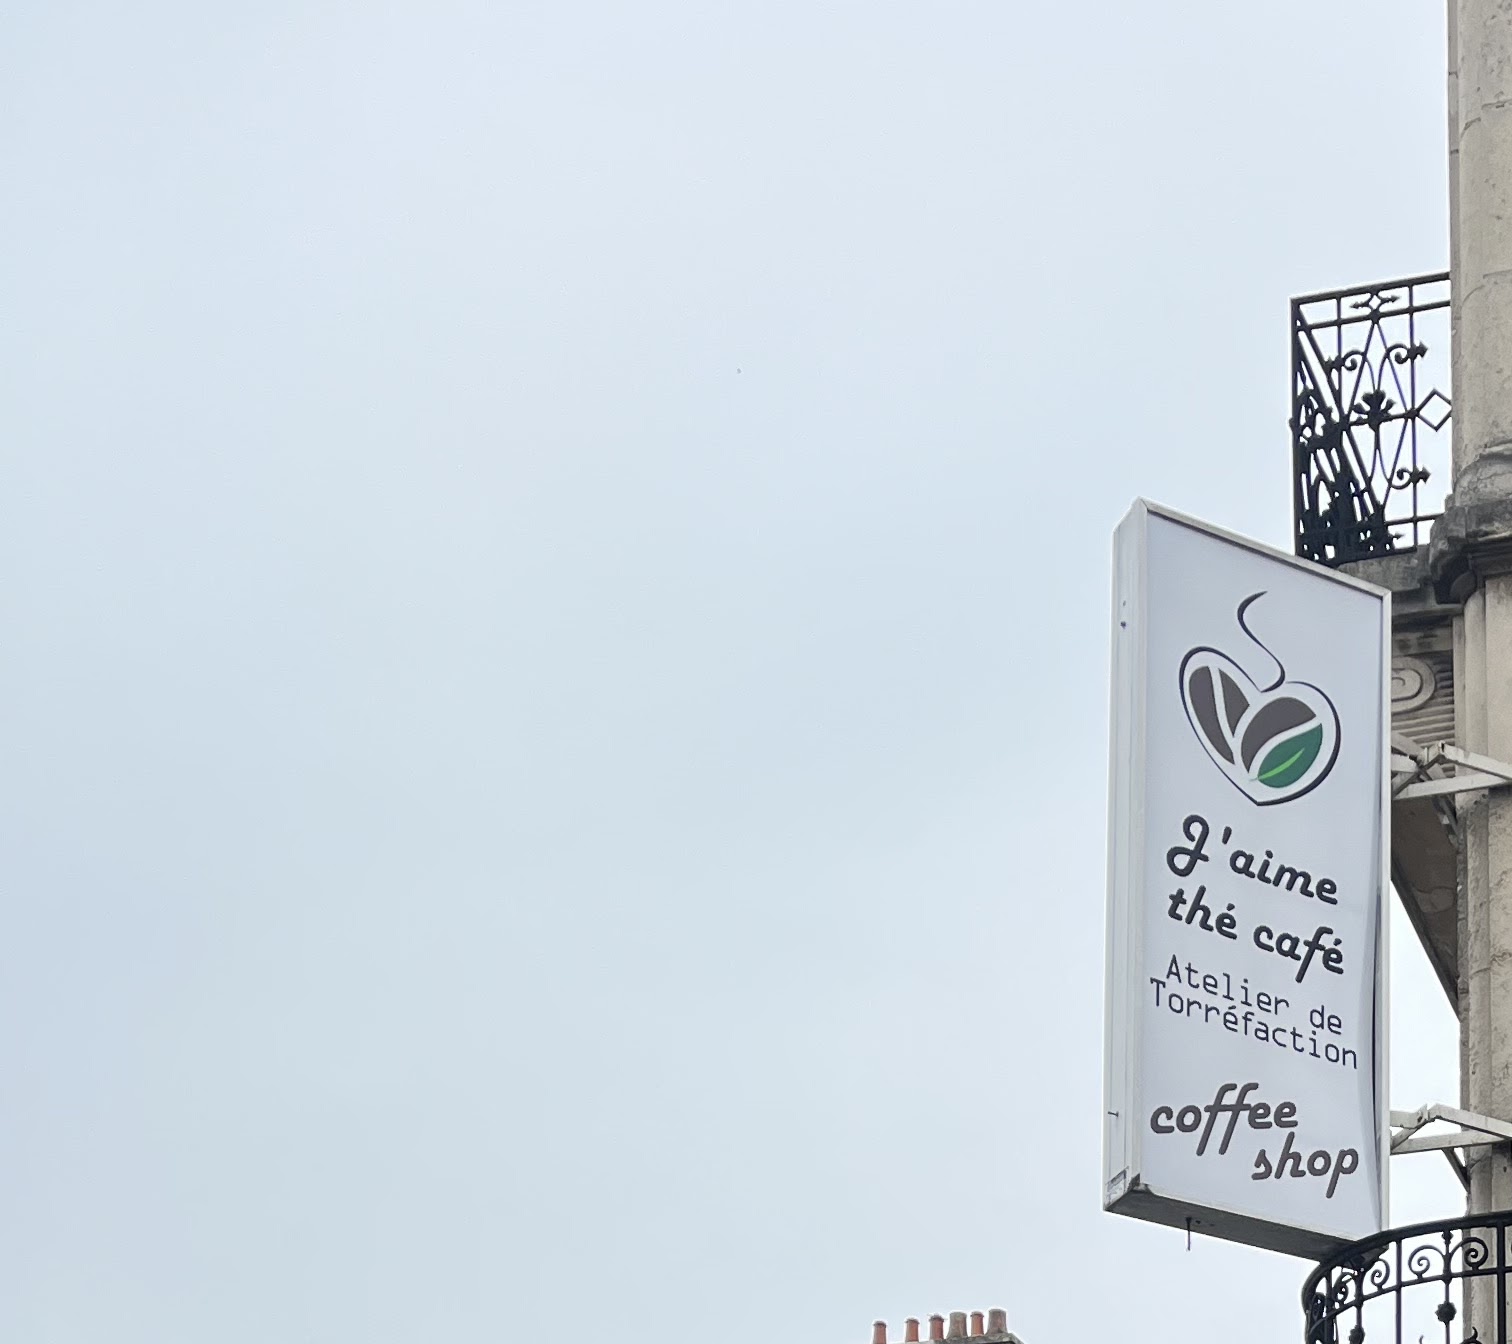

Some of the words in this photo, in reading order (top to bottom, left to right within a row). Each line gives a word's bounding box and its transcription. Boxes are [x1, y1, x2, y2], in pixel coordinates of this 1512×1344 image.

[1166, 814, 1339, 906] J'aime
[1167, 884, 1238, 941] thé
[1253, 925, 1345, 984] café
[1149, 976, 1358, 1070] Torréfaction
[1165, 954, 1290, 1016] Atelier
[1309, 1004, 1343, 1036] de
[1150, 1082, 1299, 1157] coffee
[1251, 1131, 1359, 1199] shop
